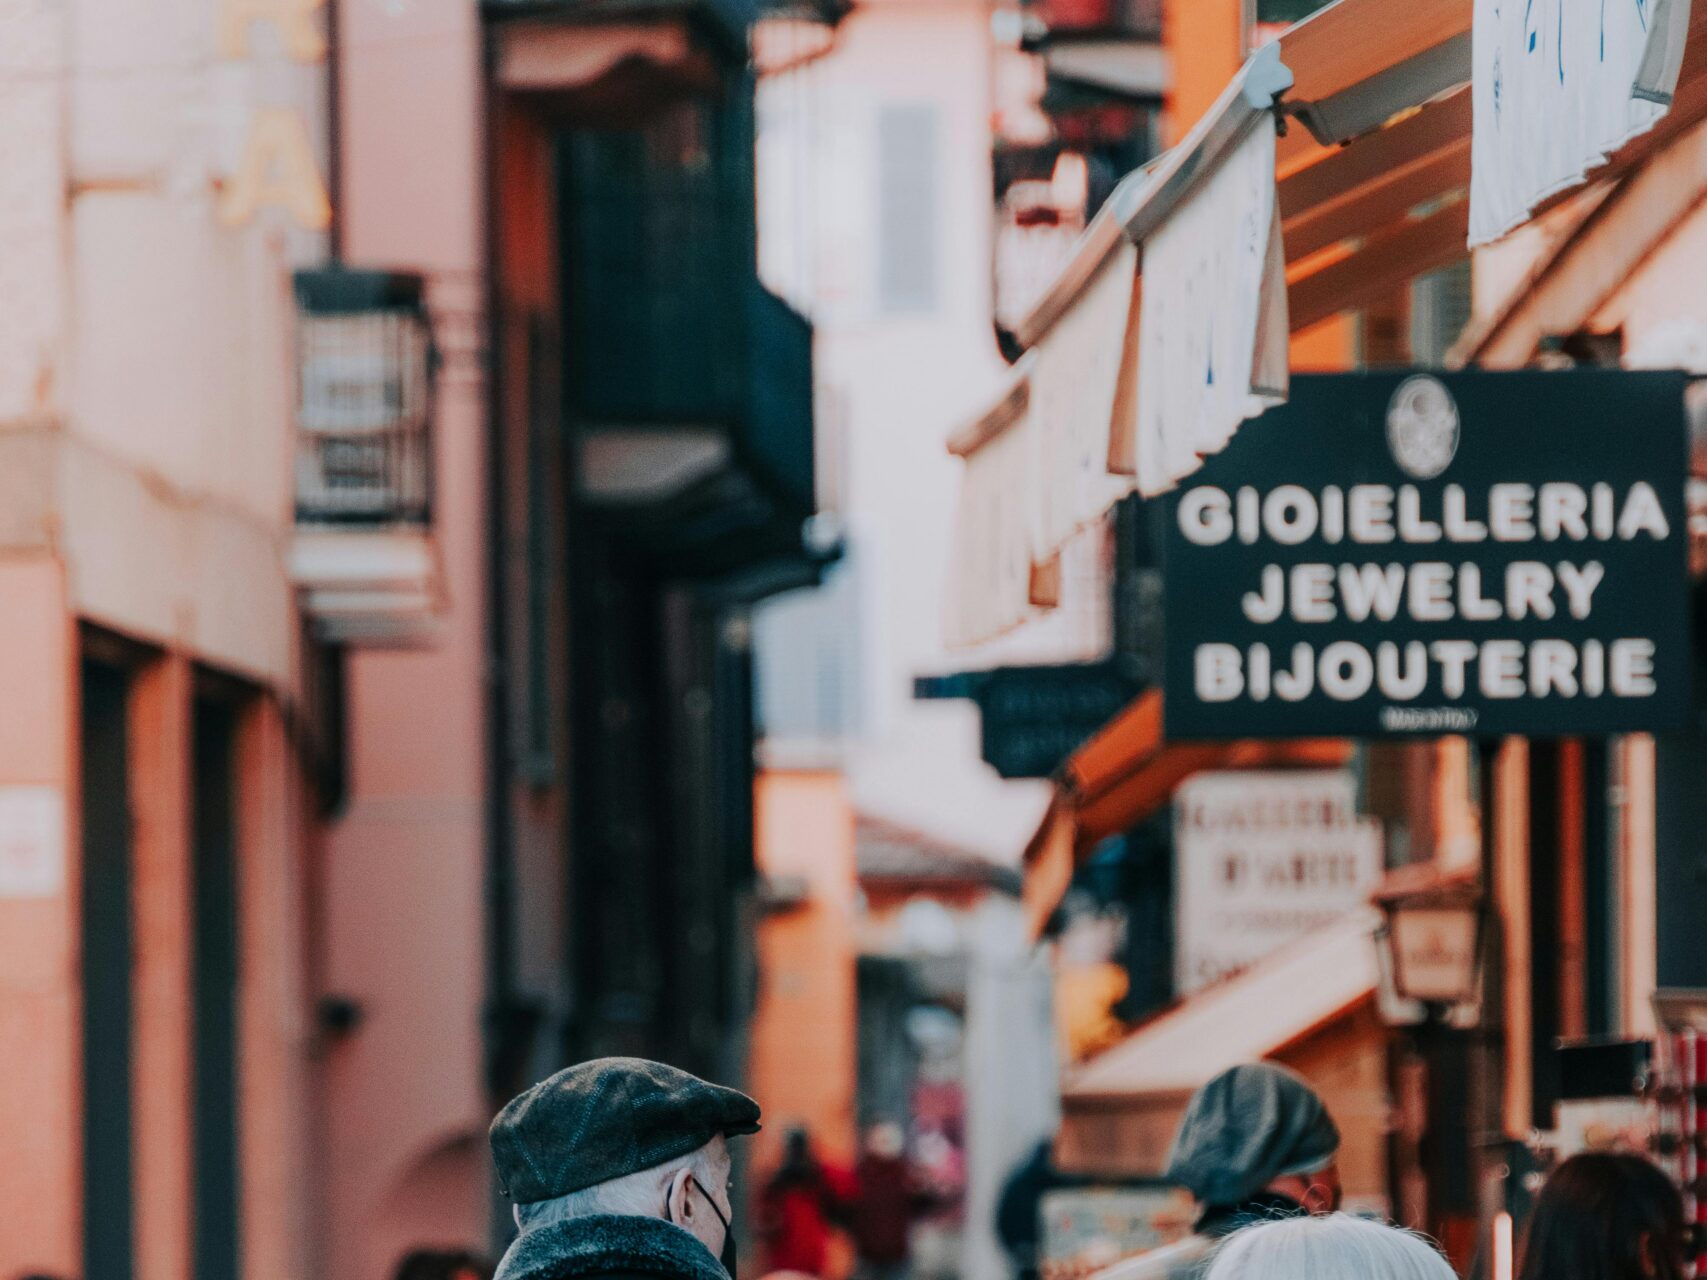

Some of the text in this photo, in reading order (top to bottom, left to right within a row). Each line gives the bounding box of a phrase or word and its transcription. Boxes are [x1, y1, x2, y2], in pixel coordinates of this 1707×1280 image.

[1177, 481, 1670, 546] GIOIELLERIA
[1242, 560, 1605, 624] JEWELRY
[1194, 638, 1657, 702] BIJOUTERIE
